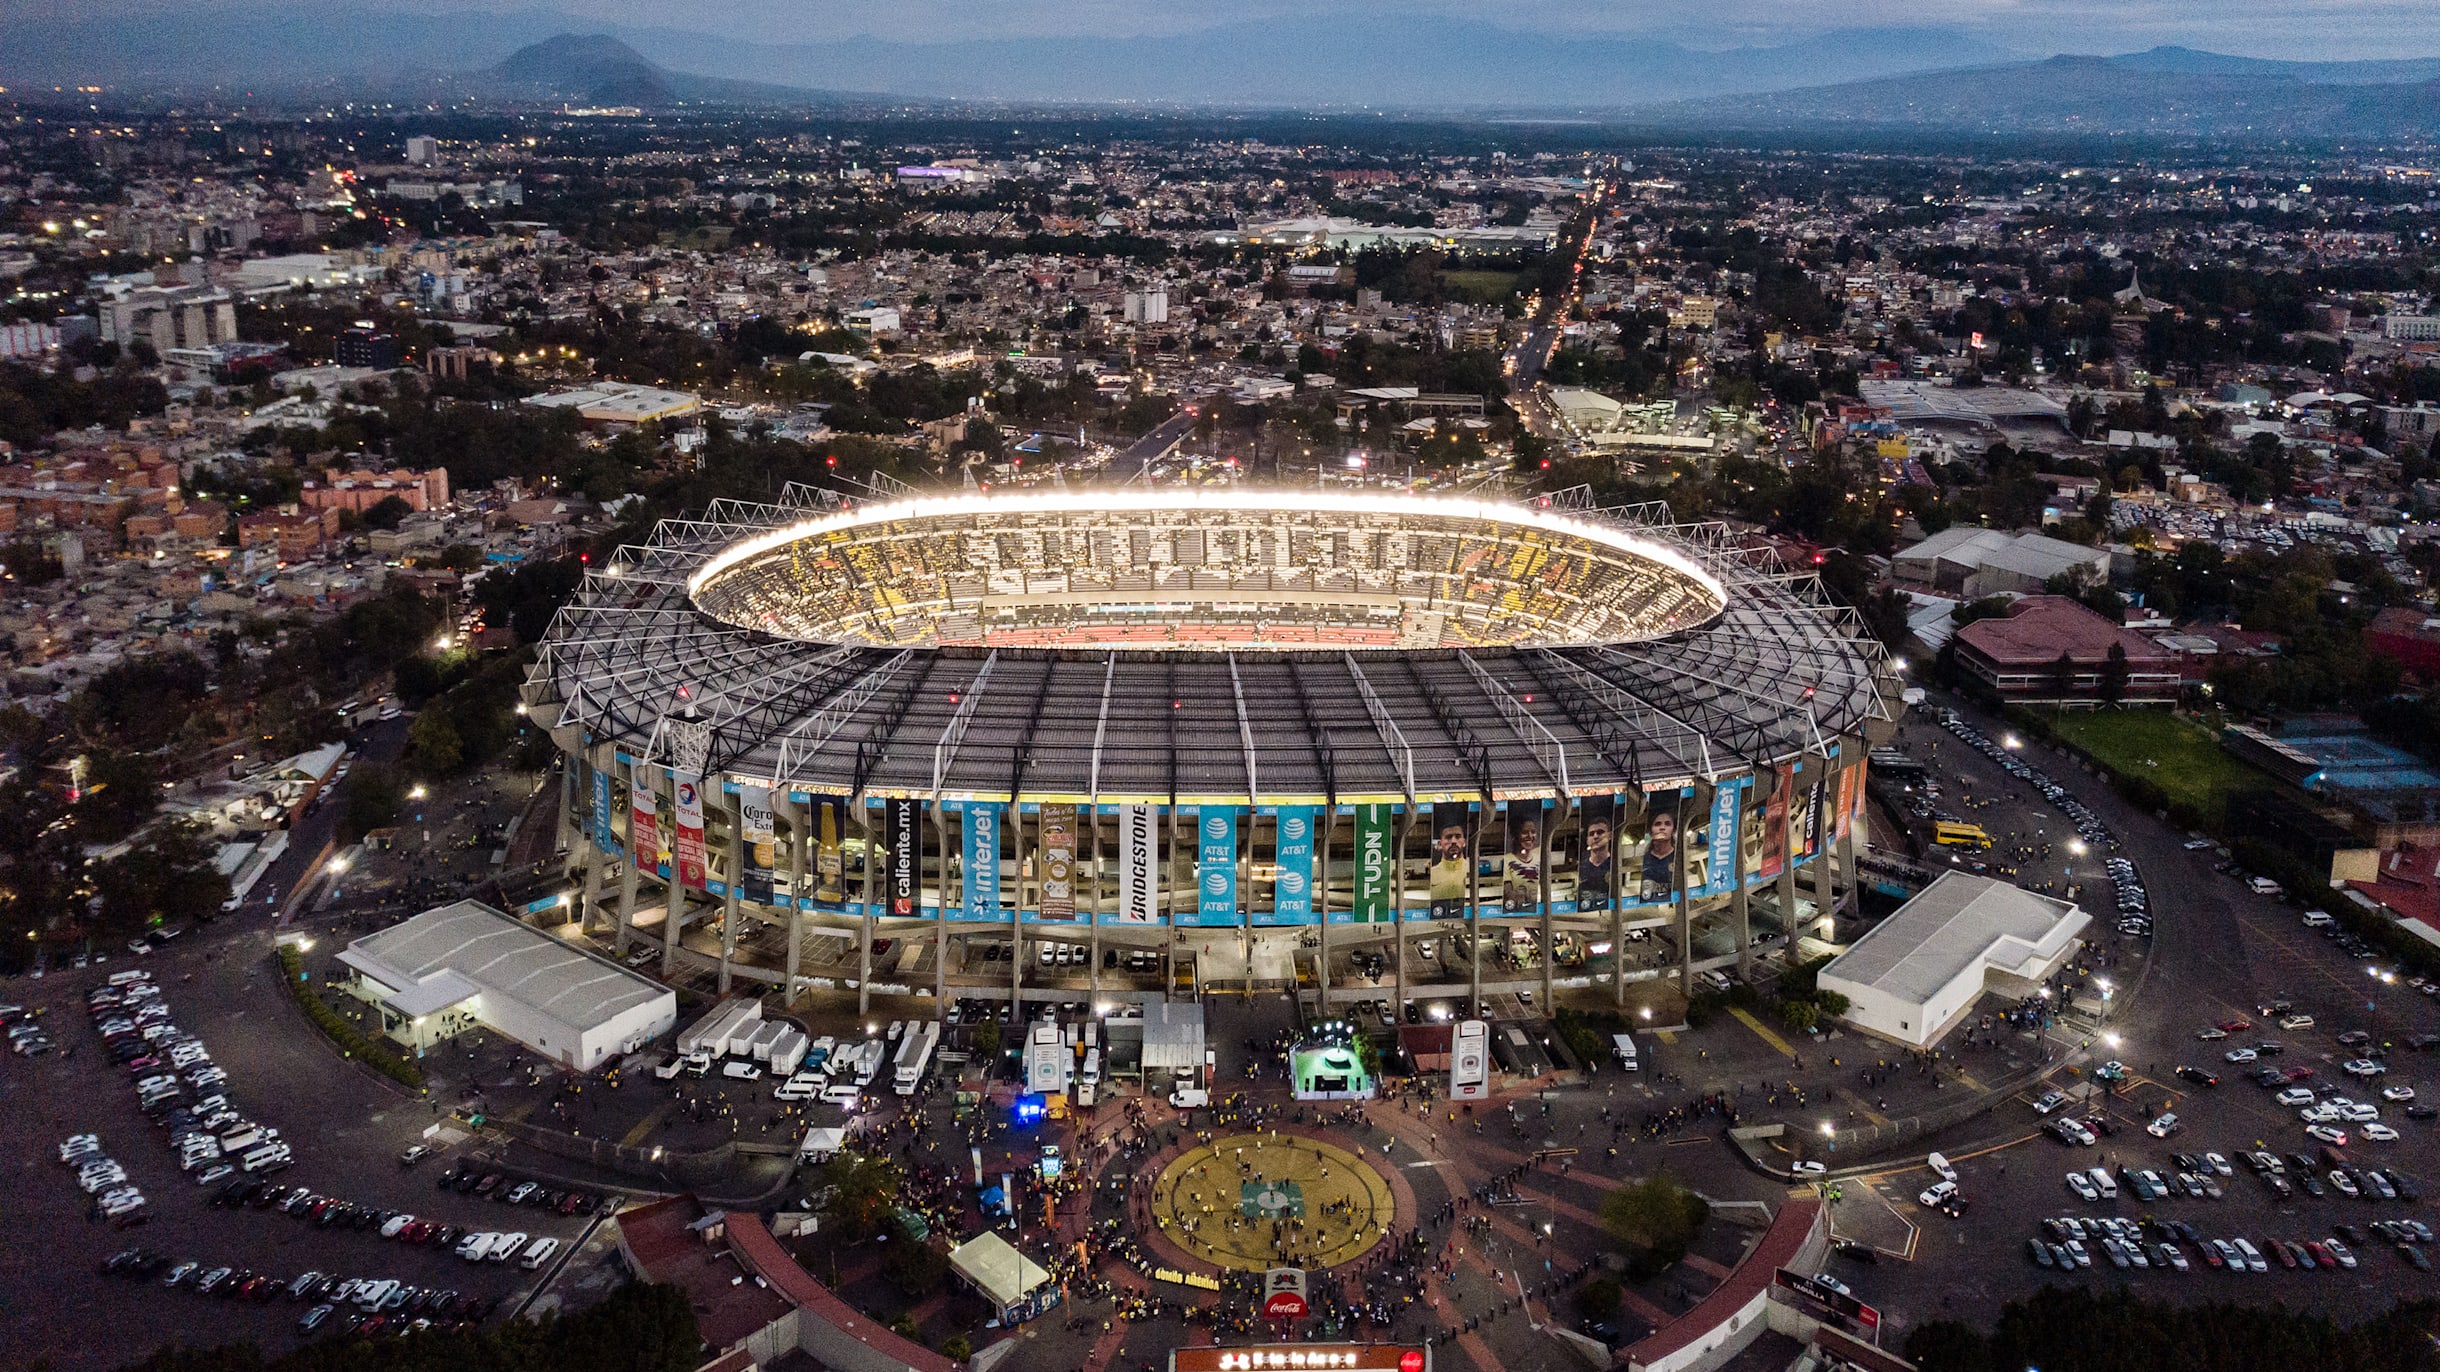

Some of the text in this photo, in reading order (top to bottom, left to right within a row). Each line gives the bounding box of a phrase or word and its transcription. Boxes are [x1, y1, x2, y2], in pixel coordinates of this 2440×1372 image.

[677, 805, 702, 818] TOTAL
[1806, 781, 1819, 839] caliente
[895, 801, 911, 897] caliente.mx
[1204, 846, 1230, 856] AT&T
[1281, 845, 1307, 855] AT&T
[1131, 805, 1147, 922] BRIDGESTONE
[1364, 831, 1382, 899] TUDN
[1204, 902, 1230, 912] AT&T
[1280, 900, 1306, 910] AT&T
[1792, 1281, 1825, 1301] TAQUILLA
[1270, 1302, 1301, 1313] Coca-Cola
